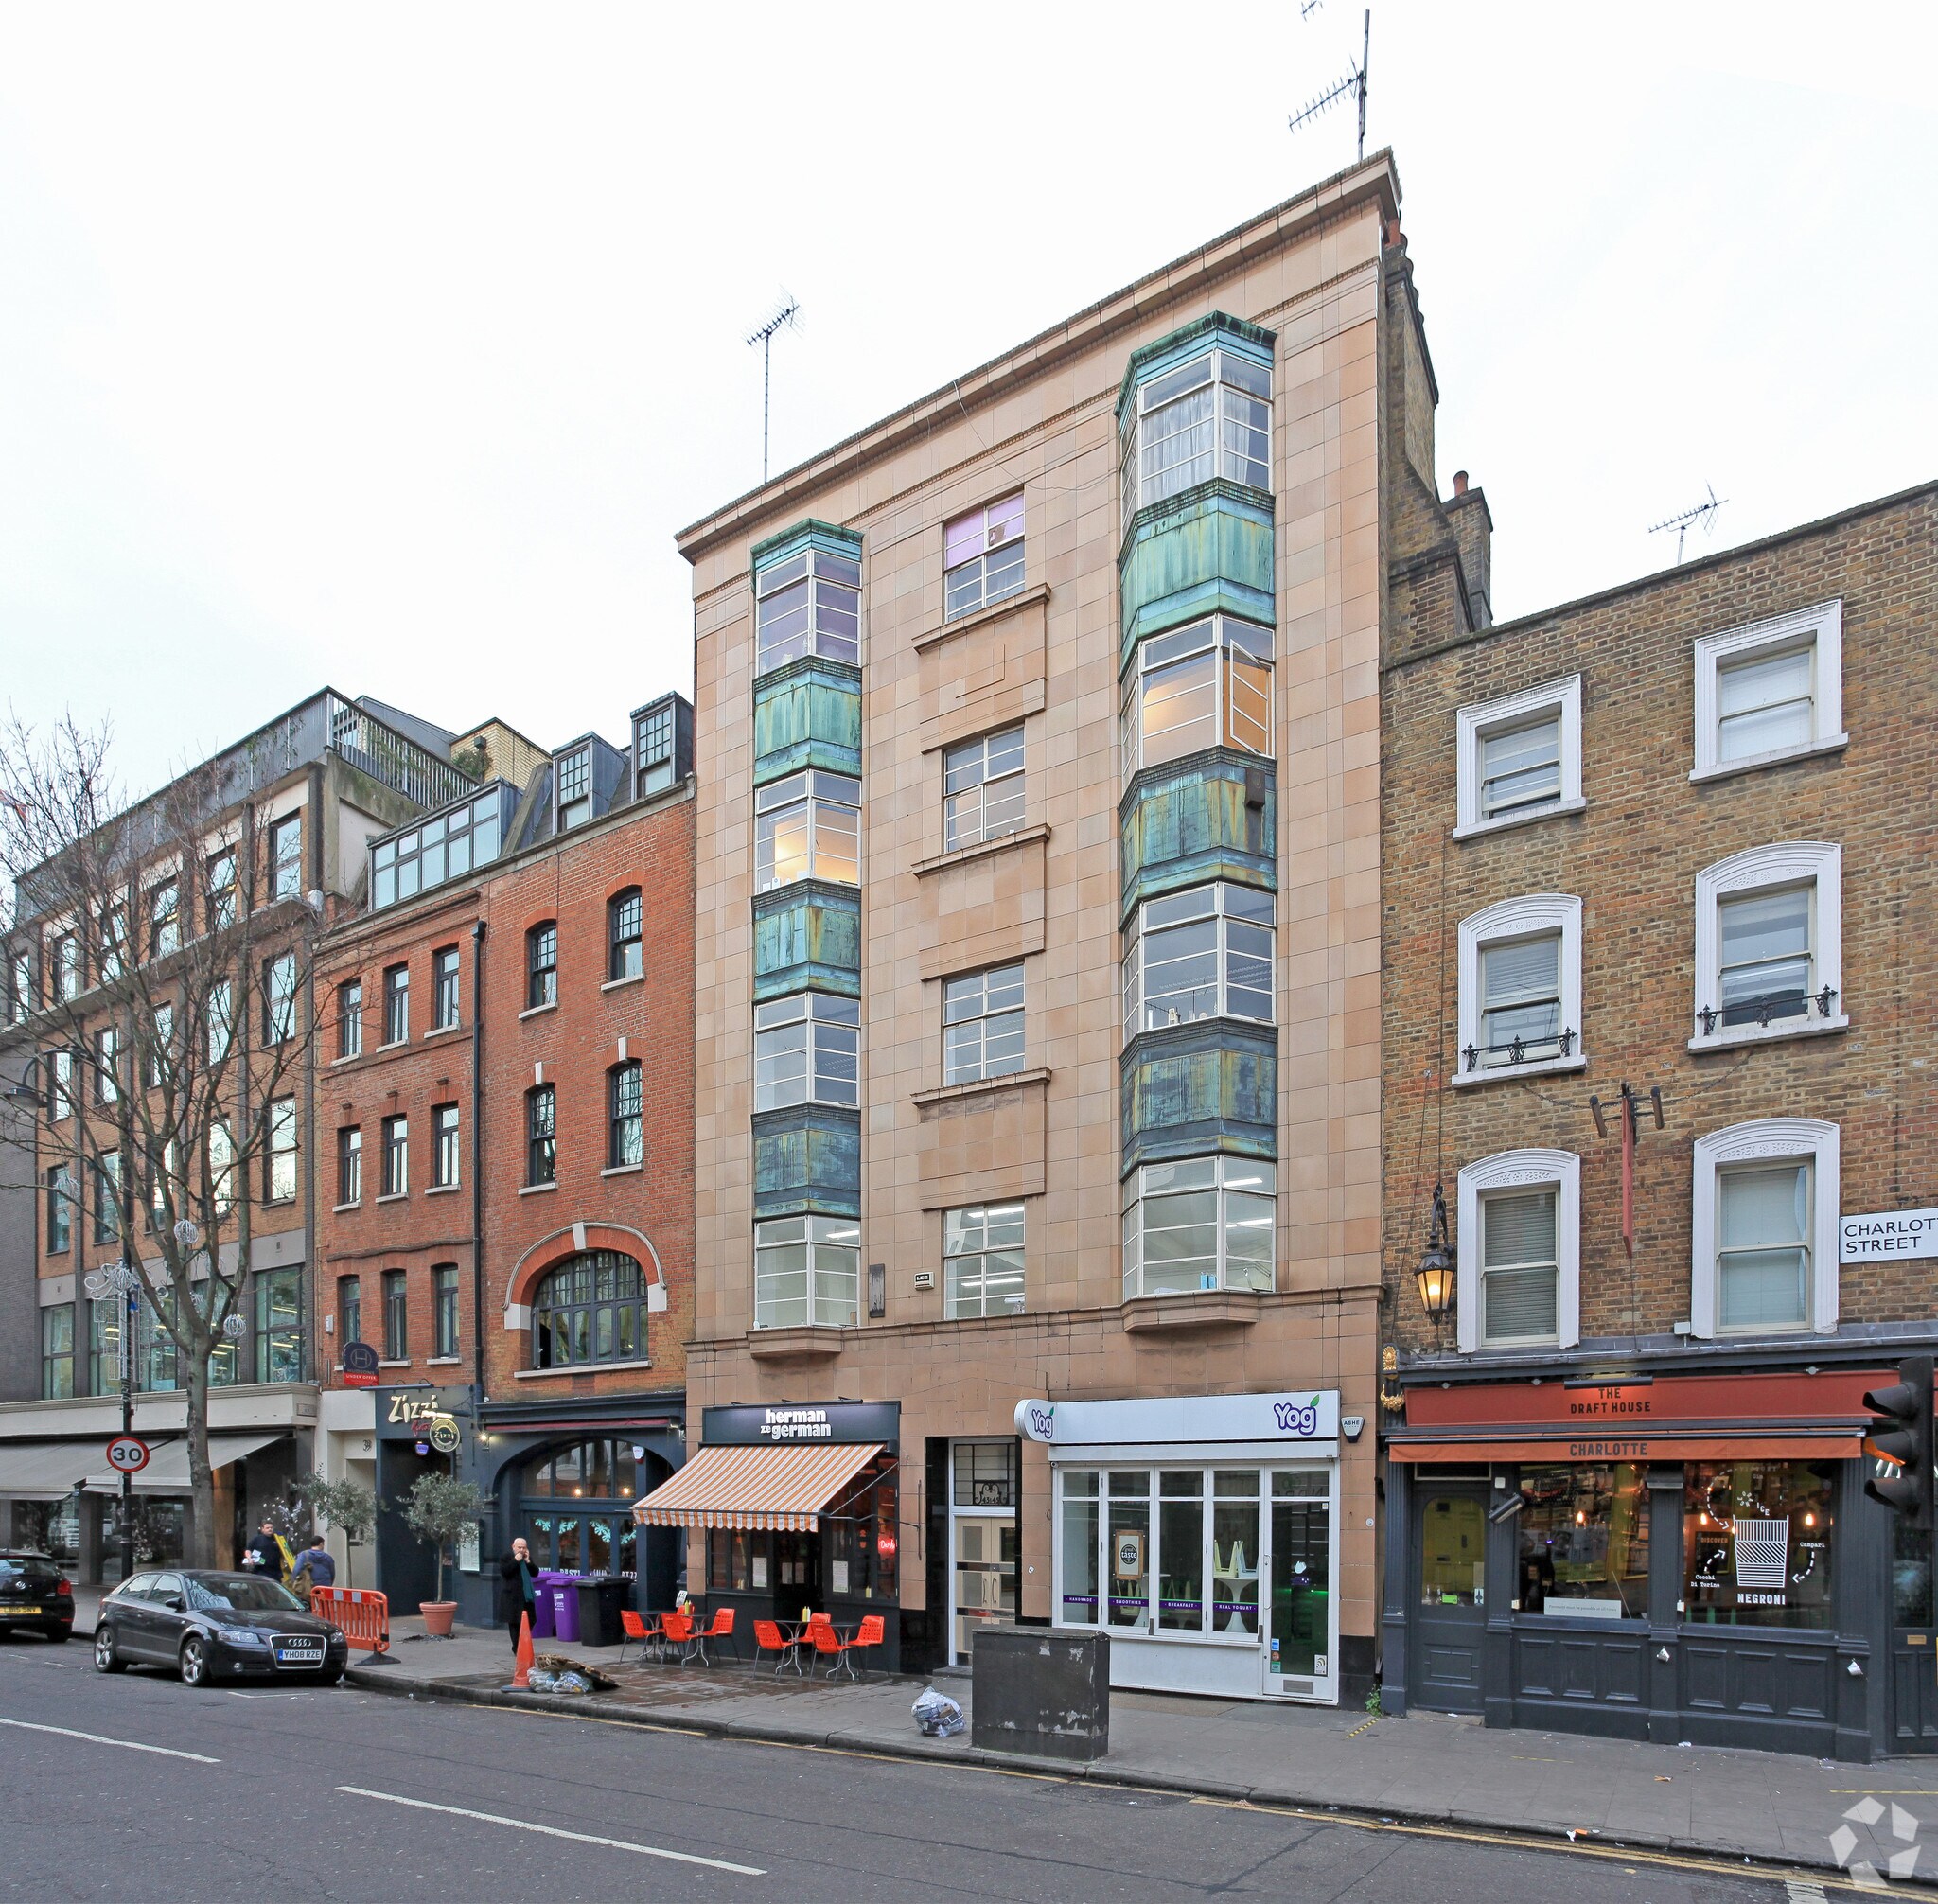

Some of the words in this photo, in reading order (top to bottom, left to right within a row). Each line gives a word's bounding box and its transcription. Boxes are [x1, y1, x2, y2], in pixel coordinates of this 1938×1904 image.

[1844, 1218, 1938, 1237] CHARLOT
[1845, 1236, 1921, 1254] STREET
[1598, 1388, 1621, 1399] THE
[766, 1408, 826, 1423] herman
[1571, 1402, 1607, 1414] DRAFT
[1612, 1402, 1650, 1413] HOUSE
[1031, 1409, 1053, 1439] Yog
[1274, 1402, 1316, 1436] Yog
[433, 1431, 454, 1439] Zizzi
[760, 1425, 771, 1434] ze
[771, 1424, 832, 1440] german
[113, 1447, 142, 1462] 30
[1570, 1443, 1647, 1456] CHARLOTTE
[1756, 1502, 1770, 1516] ICE
[1737, 1593, 1786, 1605] NEGRONI
